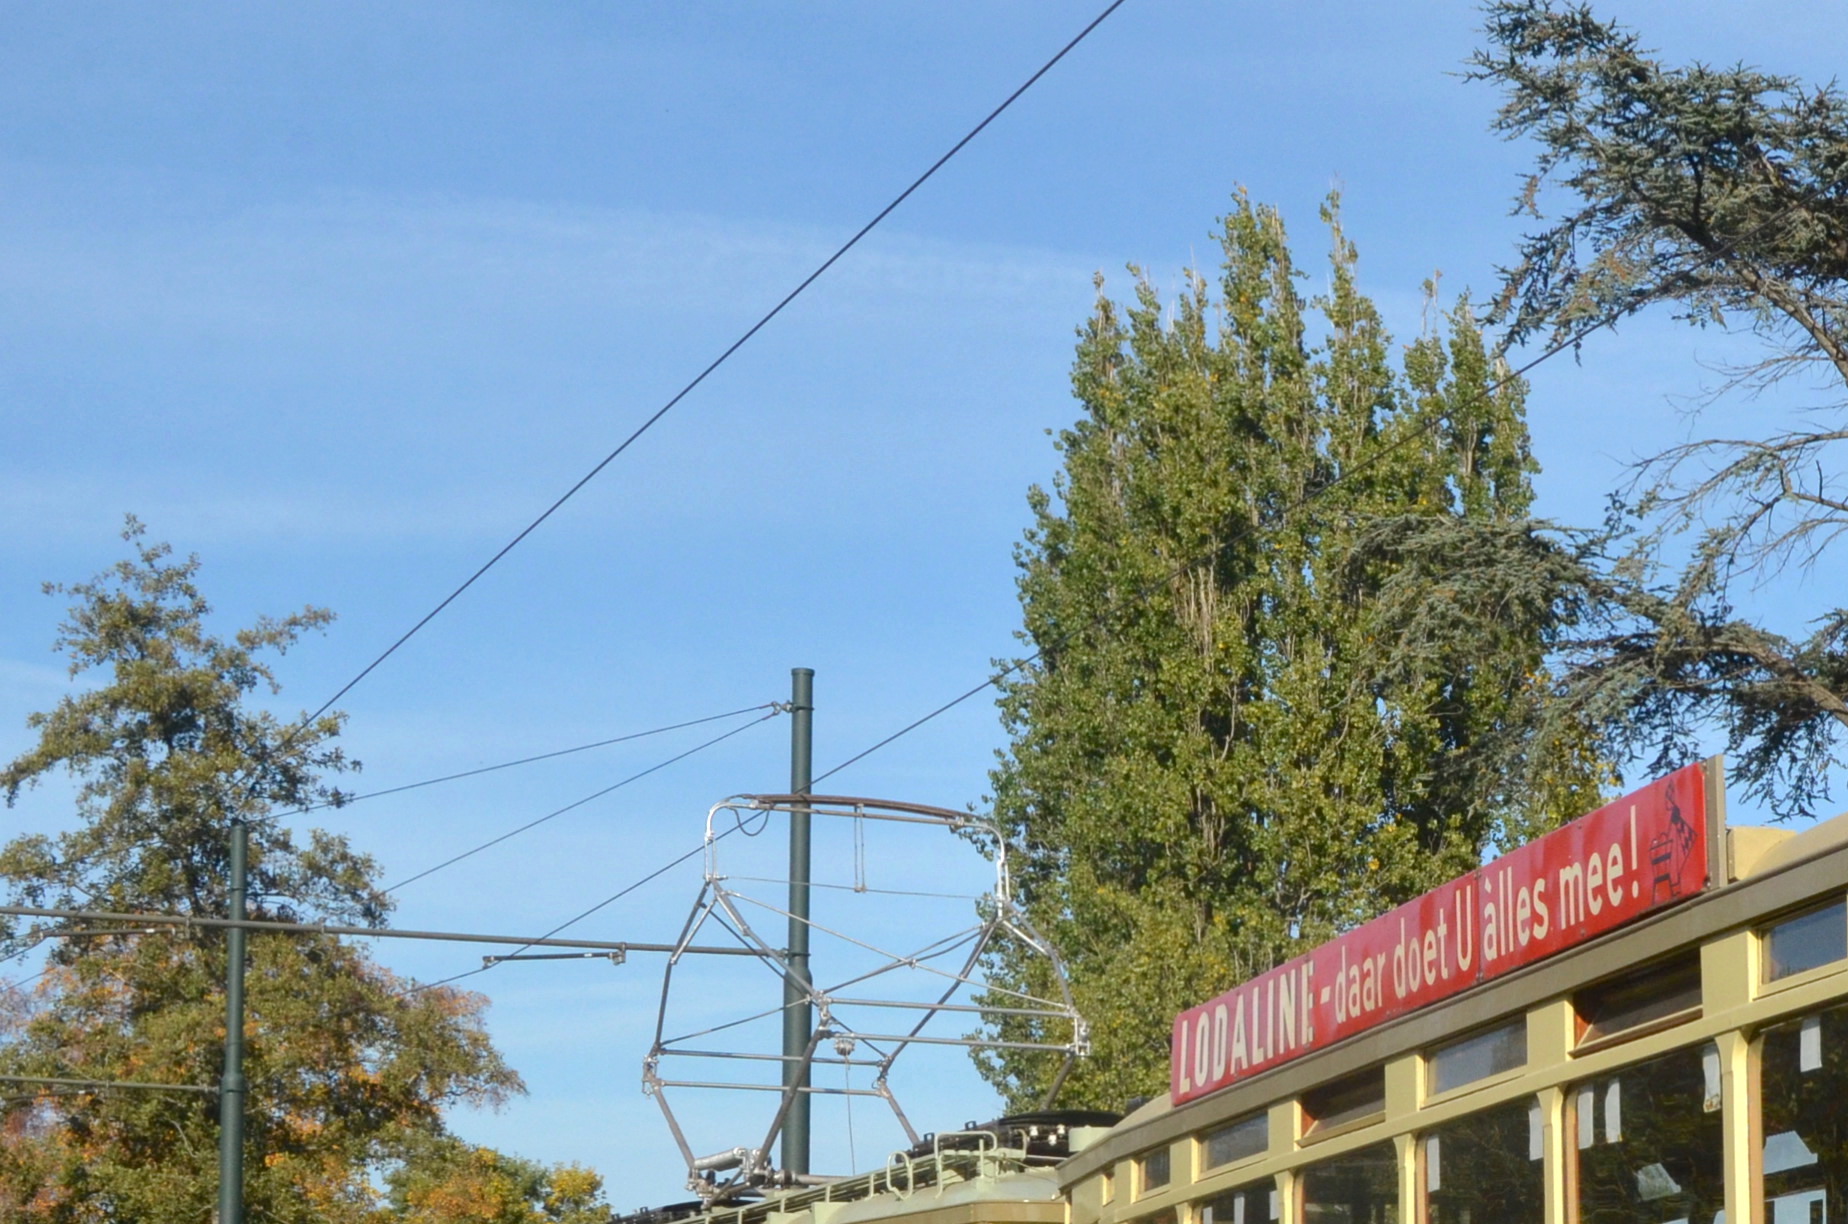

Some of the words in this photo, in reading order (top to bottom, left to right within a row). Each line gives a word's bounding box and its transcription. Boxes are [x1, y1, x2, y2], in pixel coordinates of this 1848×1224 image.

[1179, 960, 1314, 1095] LODALINE
[1392, 908, 1448, 1000] doet
[1455, 884, 1474, 972] U
[1559, 804, 1639, 931] mee!
